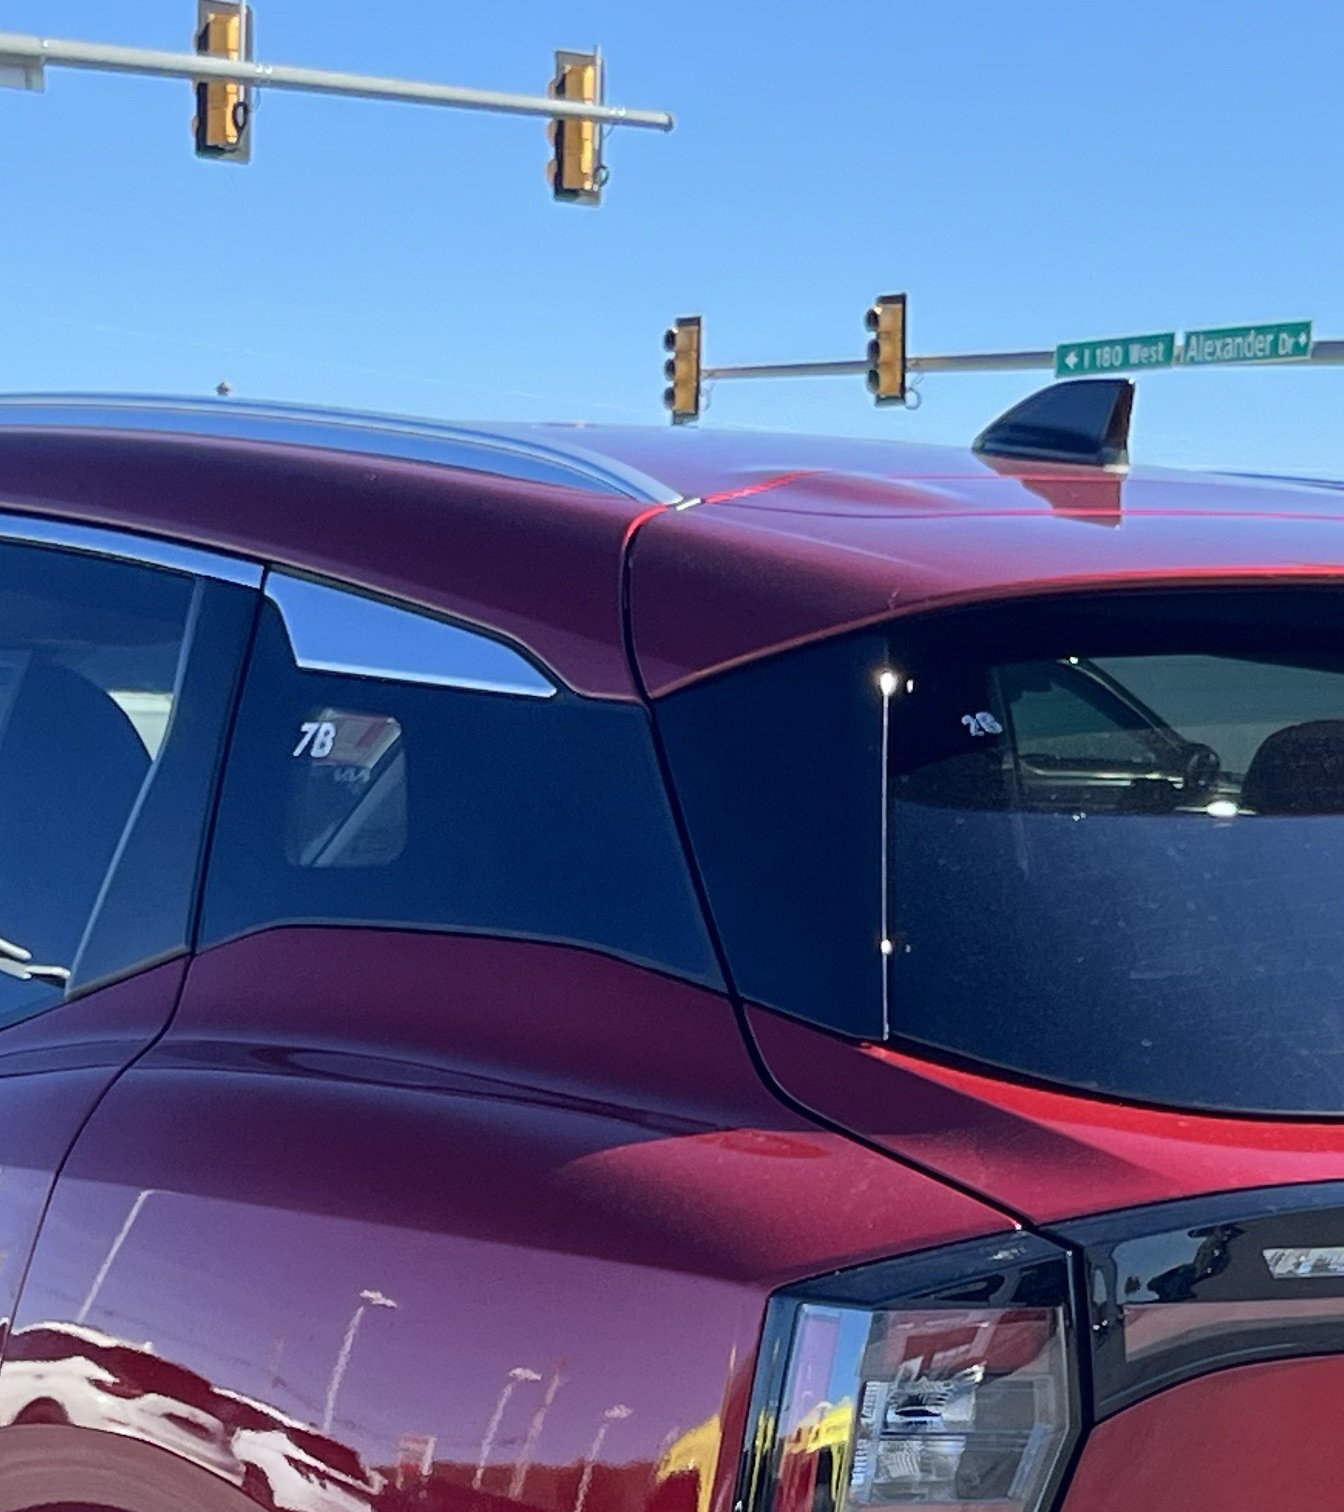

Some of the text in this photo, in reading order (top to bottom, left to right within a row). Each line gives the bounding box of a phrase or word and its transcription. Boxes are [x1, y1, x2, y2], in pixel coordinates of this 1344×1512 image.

[1095, 347, 1122, 368] 180
[1129, 342, 1165, 365] West
[1185, 330, 1296, 362] Alexander Dr
